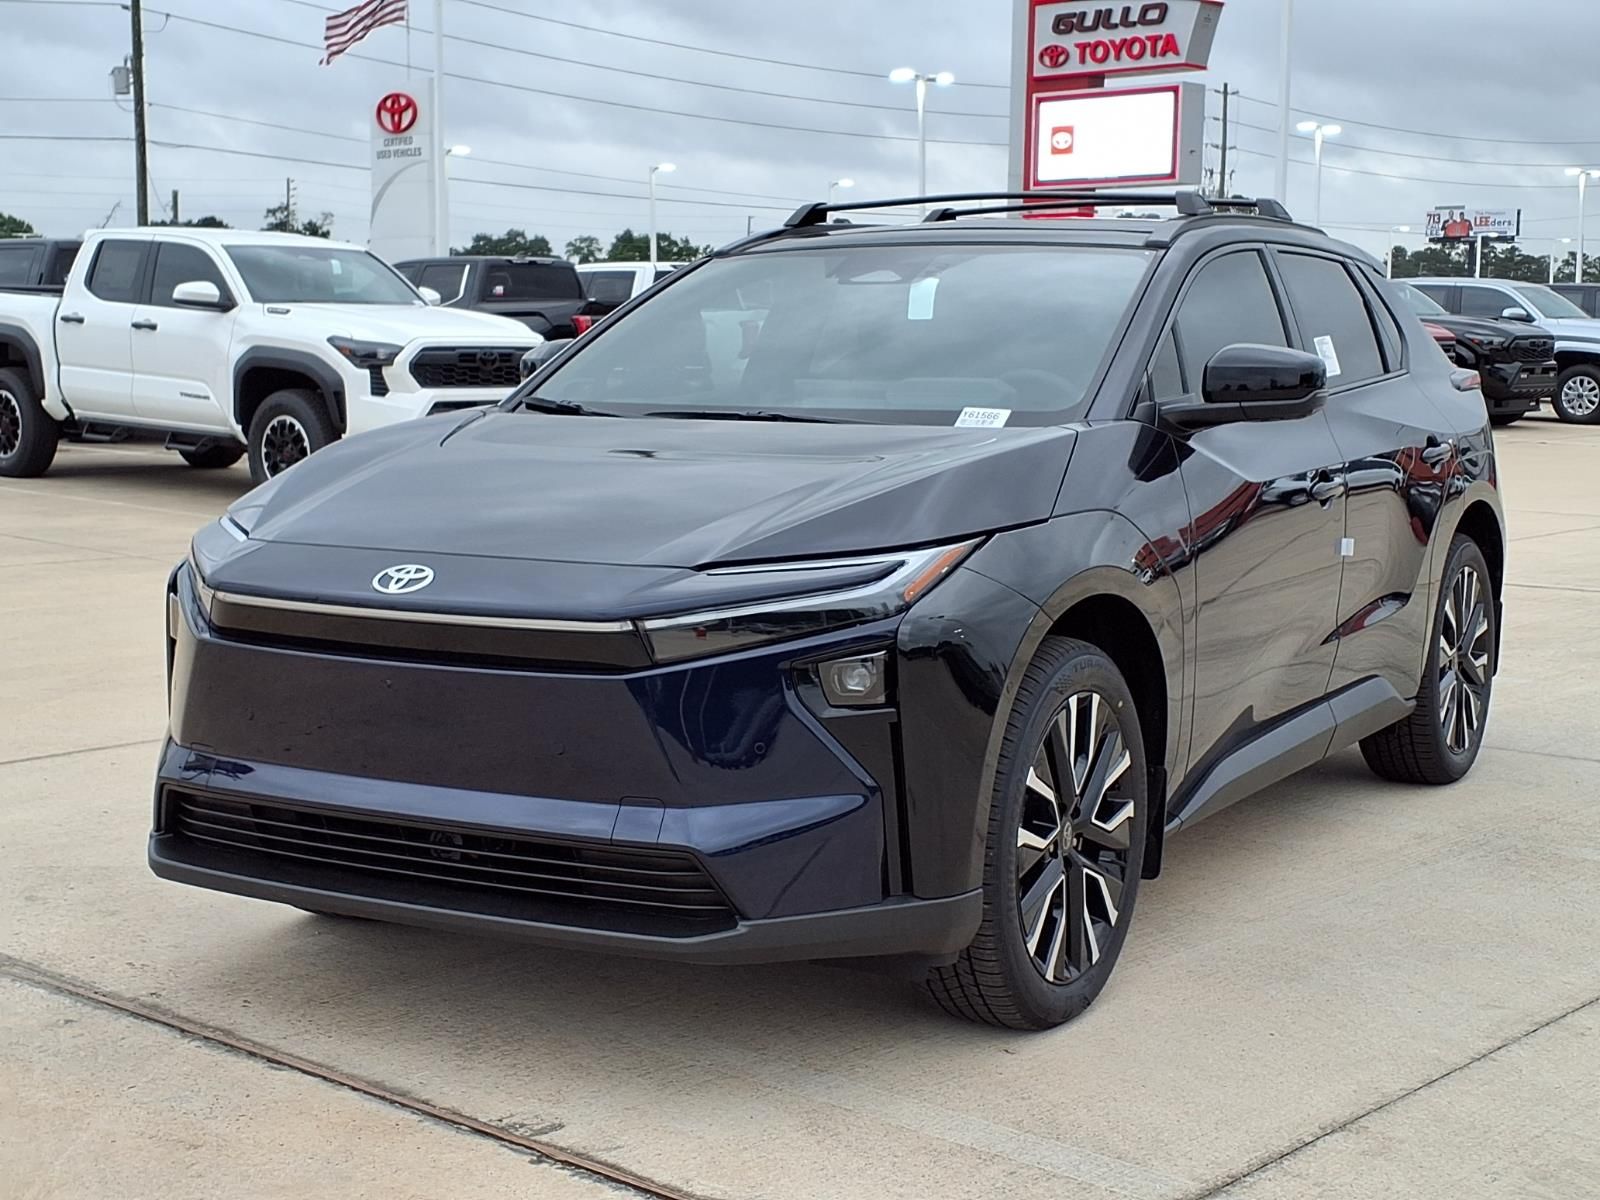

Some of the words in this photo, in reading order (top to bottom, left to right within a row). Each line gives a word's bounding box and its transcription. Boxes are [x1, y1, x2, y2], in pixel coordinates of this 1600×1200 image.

[1052, 2, 1168, 35] GULLO
[1074, 33, 1180, 65] TOYOTA
[384, 136, 413, 147] CERTIFIED
[376, 149, 392, 160] USED
[393, 147, 422, 158] VEHICLES
[1427, 213, 1441, 224] 713
[963, 410, 1001, 420] Y61566
